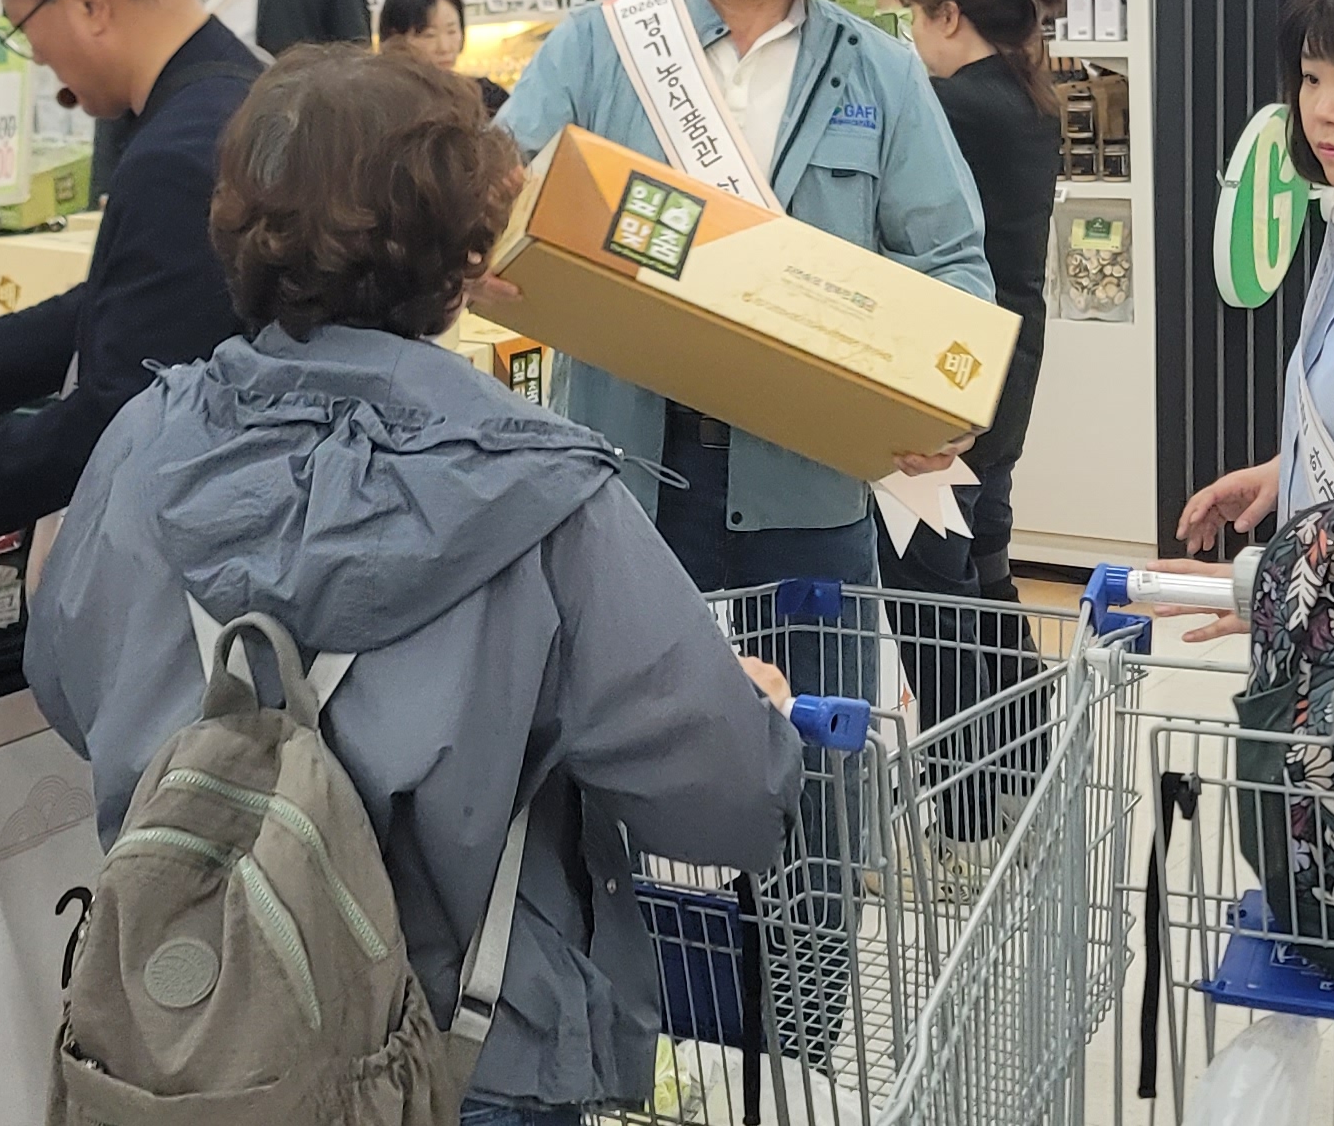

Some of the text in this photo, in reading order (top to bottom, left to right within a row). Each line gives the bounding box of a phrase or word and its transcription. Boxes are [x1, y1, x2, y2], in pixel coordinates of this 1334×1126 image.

[635, 13, 723, 169] 경기 농식품관
[1252, 114, 1299, 294] G
[944, 351, 975, 388] 배
